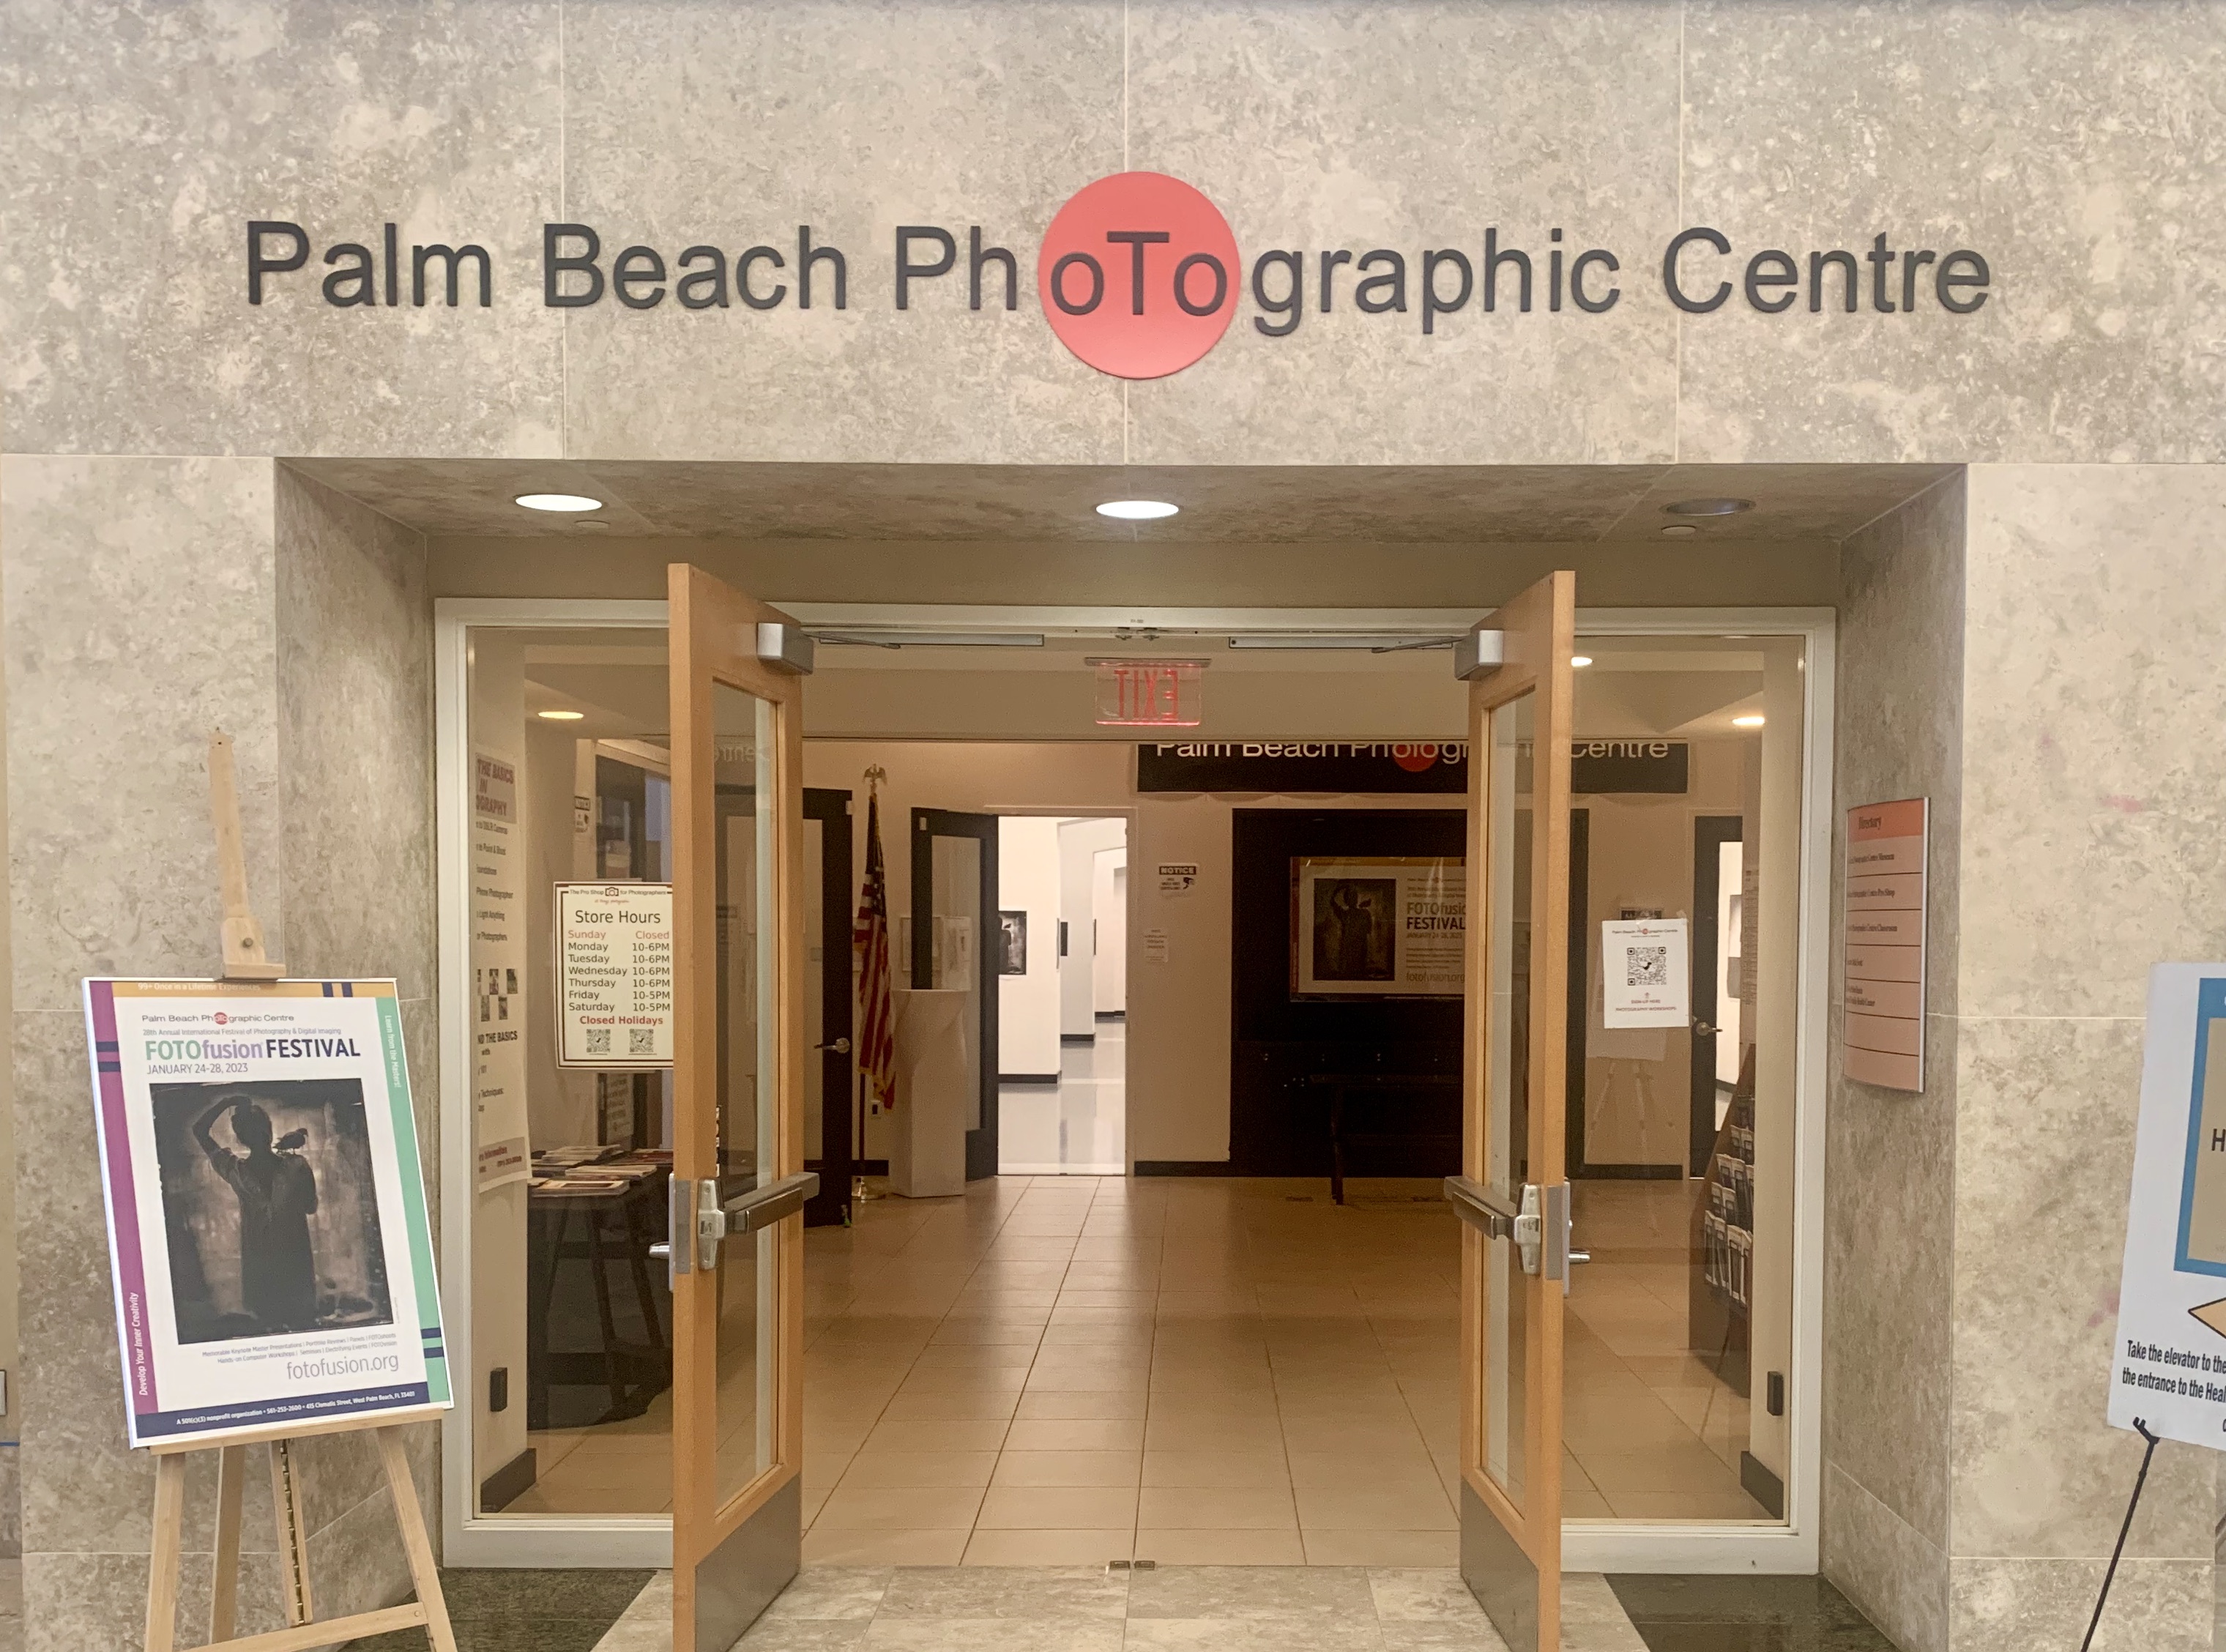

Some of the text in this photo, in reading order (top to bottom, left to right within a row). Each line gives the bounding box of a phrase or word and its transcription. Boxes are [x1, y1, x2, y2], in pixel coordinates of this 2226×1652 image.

[248, 221, 491, 308] Palm
[545, 223, 846, 310] Beach
[1663, 227, 1990, 314] Centre
[1161, 867, 1194, 875] NOTICE
[575, 910, 661, 924] Store Hours
[1407, 917, 1467, 930] FESTIVAL
[568, 930, 669, 940] Sunday Closed
[568, 942, 670, 953] Monday 10-6PM
[568, 954, 670, 964] Tuesday 10-6PM
[568, 967, 670, 977] Wednesday 10-6PM
[154, 983, 173, 991] Once
[568, 978, 670, 989] Thursday 10-6PM
[569, 990, 671, 1000] Friday 10-5PM
[569, 1002, 671, 1013] Saturday 10-5PM
[141, 1015, 165, 1023] Palm
[579, 1016, 663, 1026] Closed Holidays
[182, 1028, 220, 1036] International
[254, 1027, 291, 1036] Photography
[298, 1027, 316, 1035] Digital
[485, 1032, 496, 1043] THE
[497, 1030, 518, 1042] BASICS
[387, 1033, 395, 1049] from
[266, 1038, 361, 1058] FESTIVAL
[390, 1049, 398, 1061] the
[146, 1063, 249, 1074] JANUARY 24-28, 2023
[130, 1292, 148, 1396] Develop Your Inner Creativity
[242, 1353, 267, 1361] Computer
[2127, 1339, 2146, 1360] Take
[2148, 1344, 2162, 1362] the
[2164, 1347, 2200, 1369] elevator
[2202, 1353, 2211, 1371] to
[287, 1355, 398, 1380] fotofusion.org
[2122, 1367, 2136, 1386] the
[2137, 1372, 2176, 1394] entrance
[2178, 1377, 2187, 1396] to
[2189, 1380, 2203, 1399] the
[206, 1413, 231, 1421] nonprofit
[231, 1410, 263, 1418] organization
